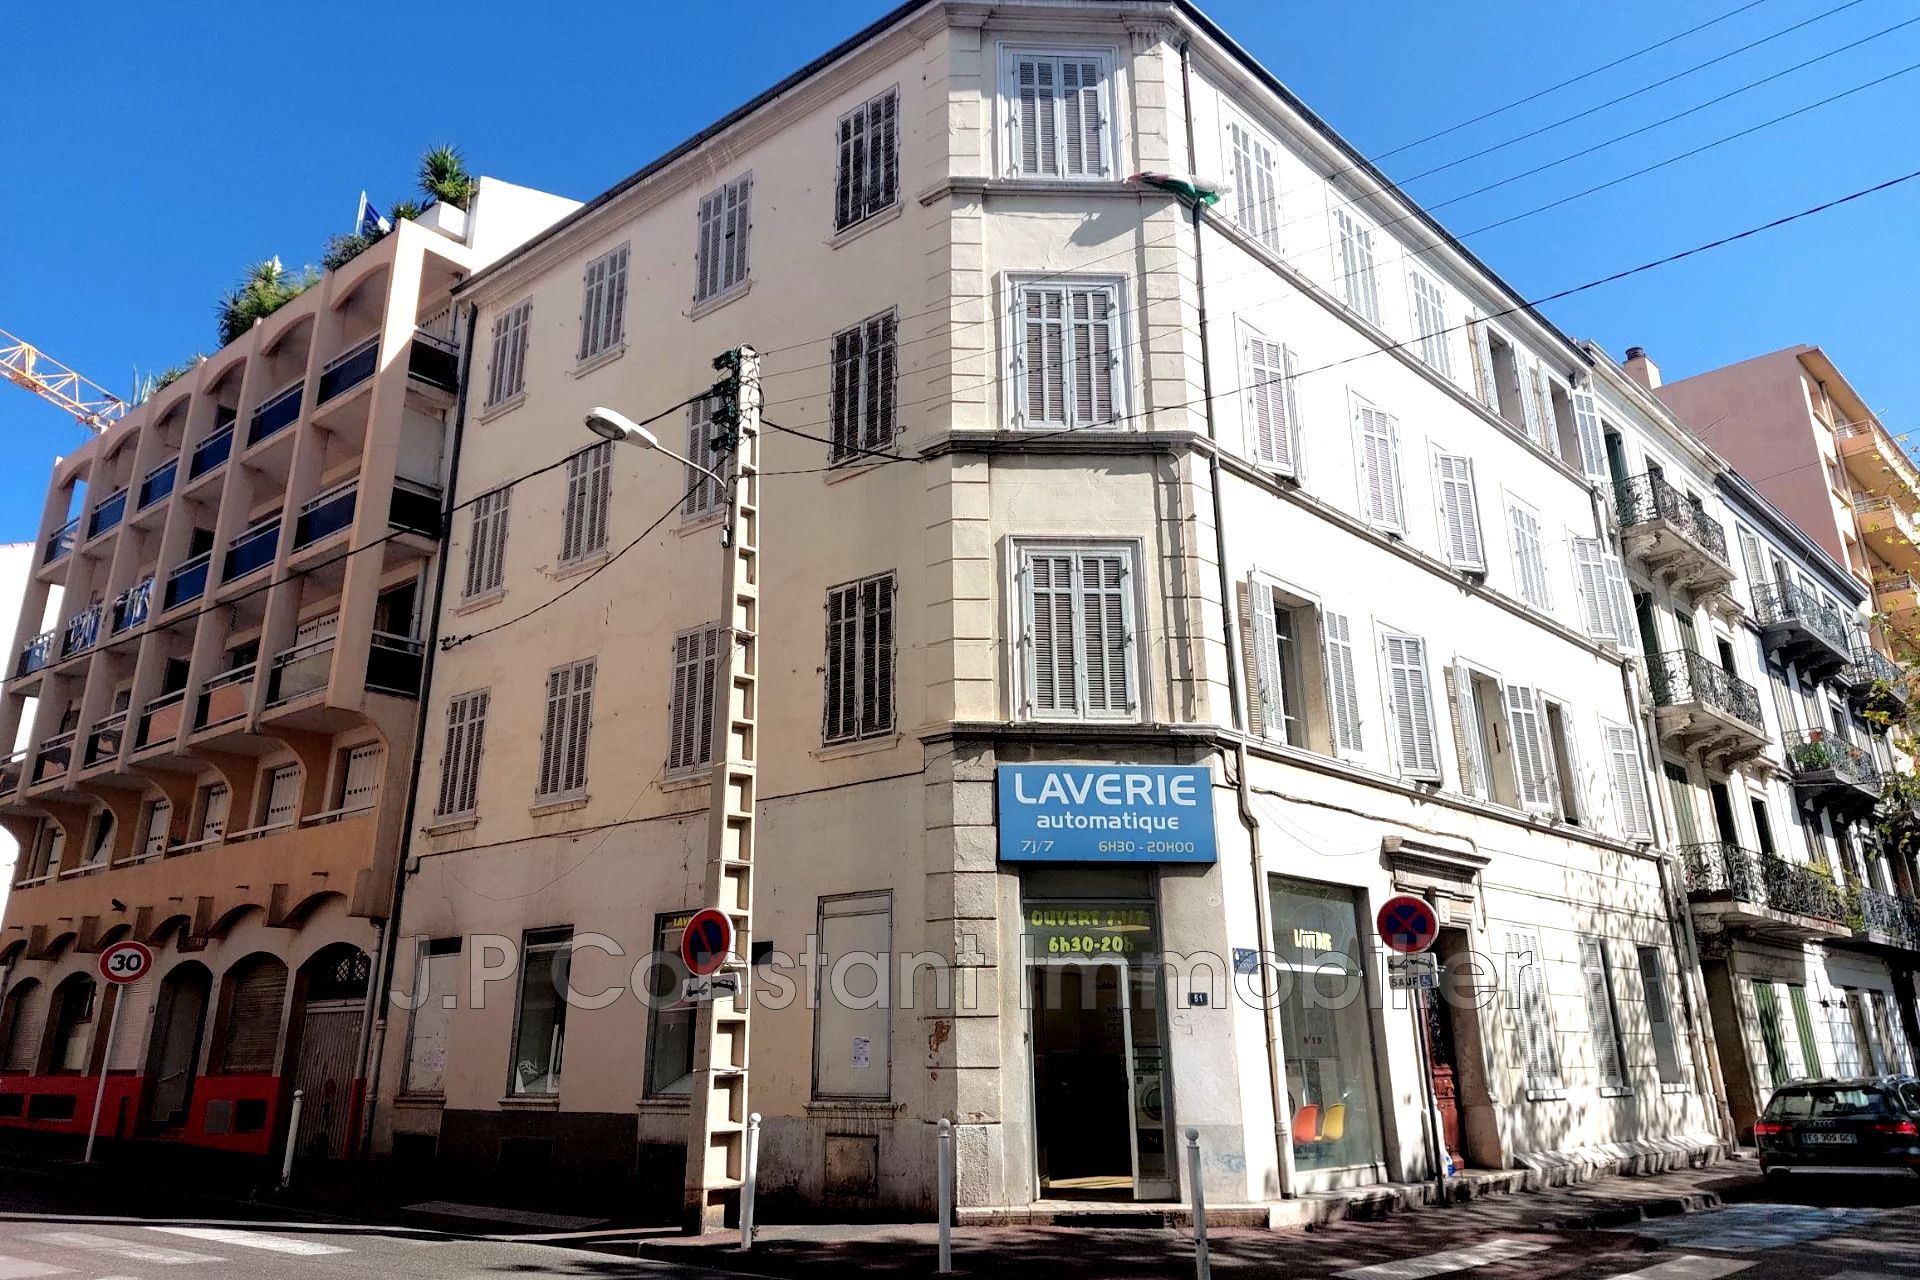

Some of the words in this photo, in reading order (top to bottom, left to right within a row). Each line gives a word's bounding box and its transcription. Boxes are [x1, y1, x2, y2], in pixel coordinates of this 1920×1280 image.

[1014, 773, 1197, 806] LAVERIE
[1036, 811, 1179, 833] automatique
[1020, 840, 1055, 854] 7j/7
[1098, 841, 1136, 853] 6H30
[1147, 841, 1195, 854] 20H00
[1031, 910, 1099, 926] OUVERT
[110, 954, 142, 971] 30
[1391, 976, 1418, 987] SAUF
